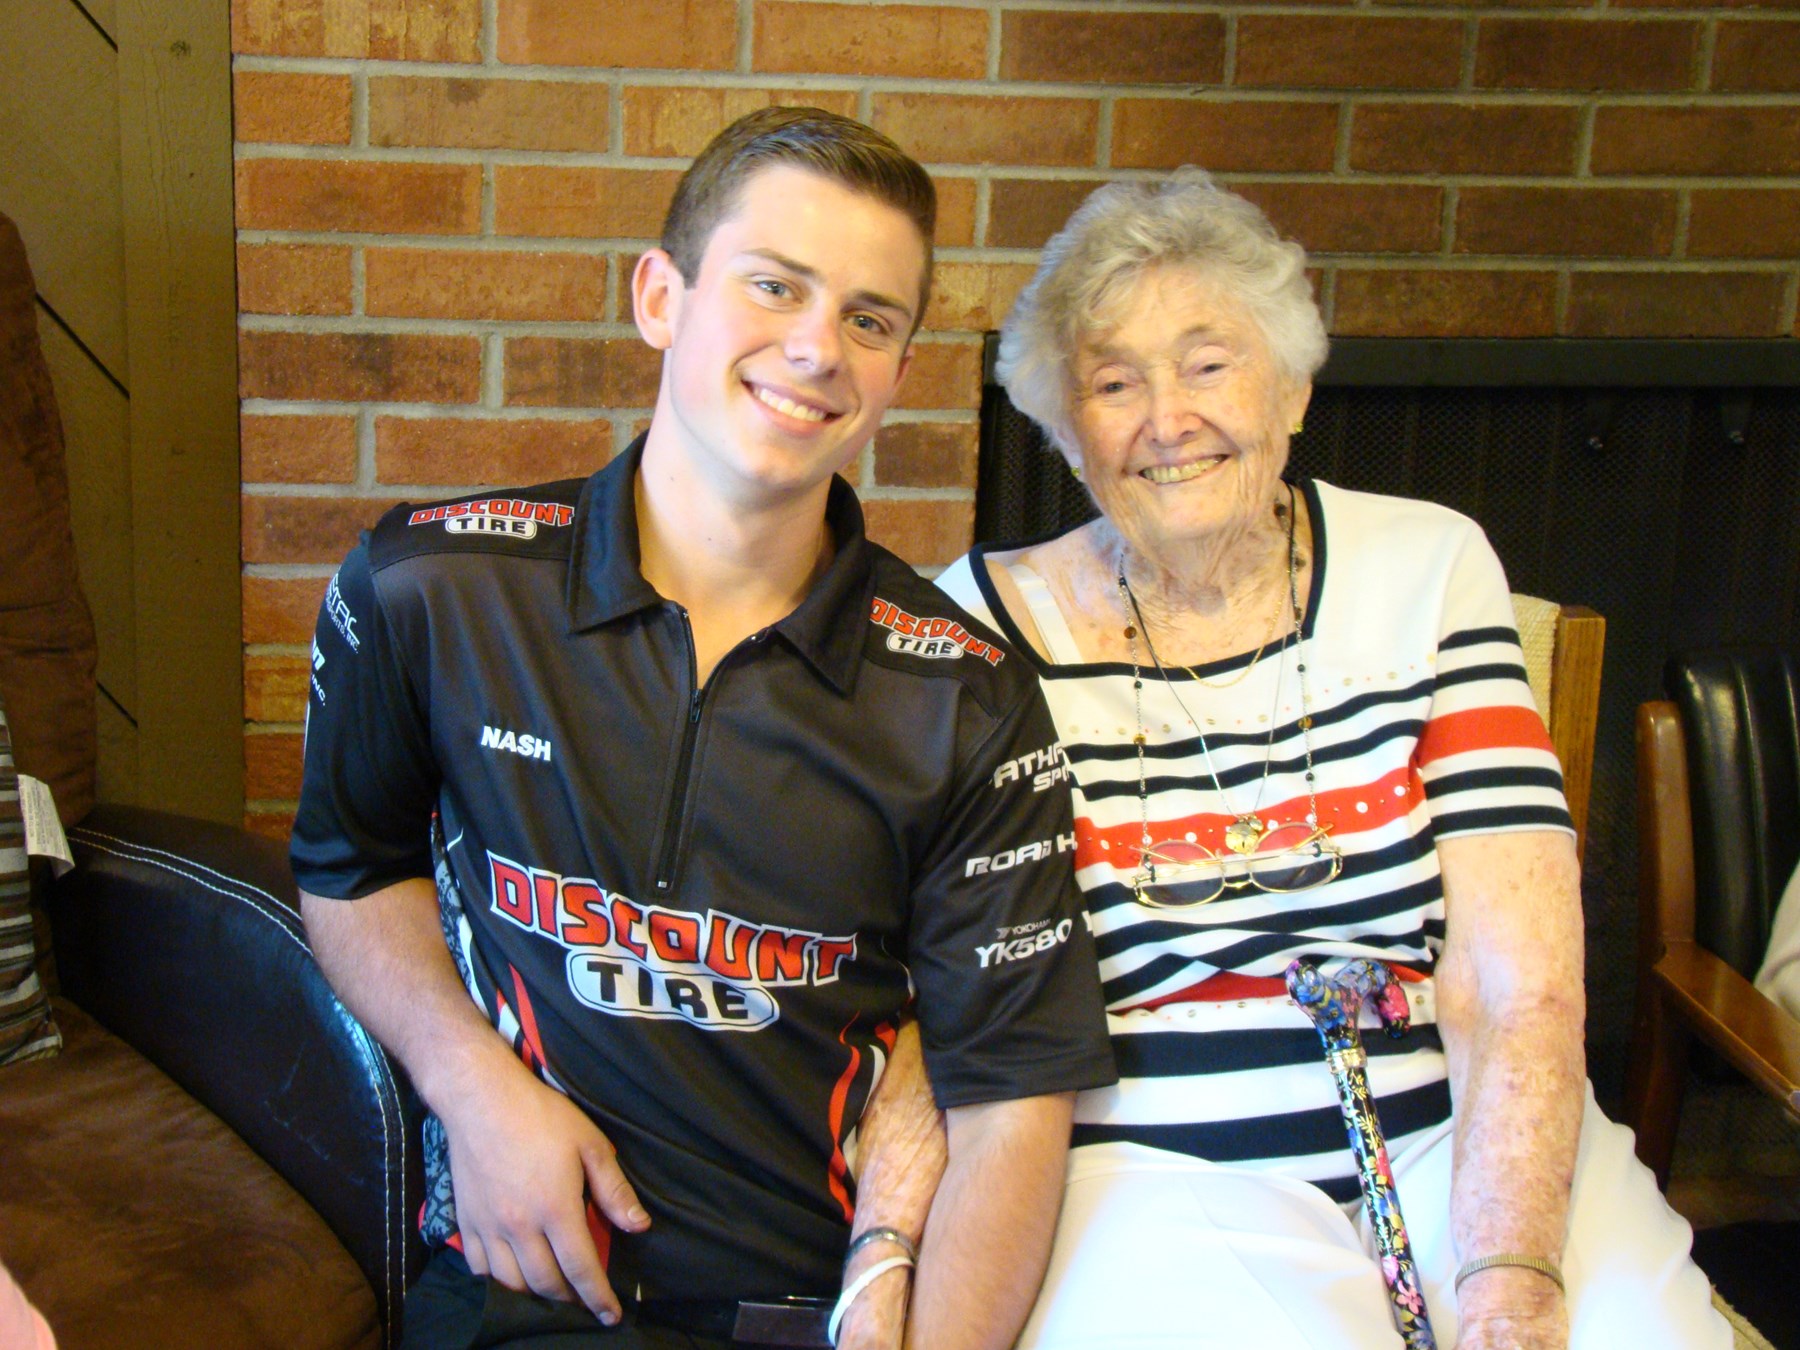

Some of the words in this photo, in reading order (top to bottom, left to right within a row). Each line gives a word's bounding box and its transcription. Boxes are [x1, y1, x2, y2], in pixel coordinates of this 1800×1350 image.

[408, 499, 575, 527] DISCOUNT
[456, 518, 527, 534] TIRE
[870, 597, 1005, 666] DISCOUNT
[898, 636, 955, 655] TIRE
[481, 725, 551, 761] NASH
[486, 849, 857, 986] DISCOUNT
[975, 918, 1073, 969] YK580
[586, 960, 750, 1020] TIRE
